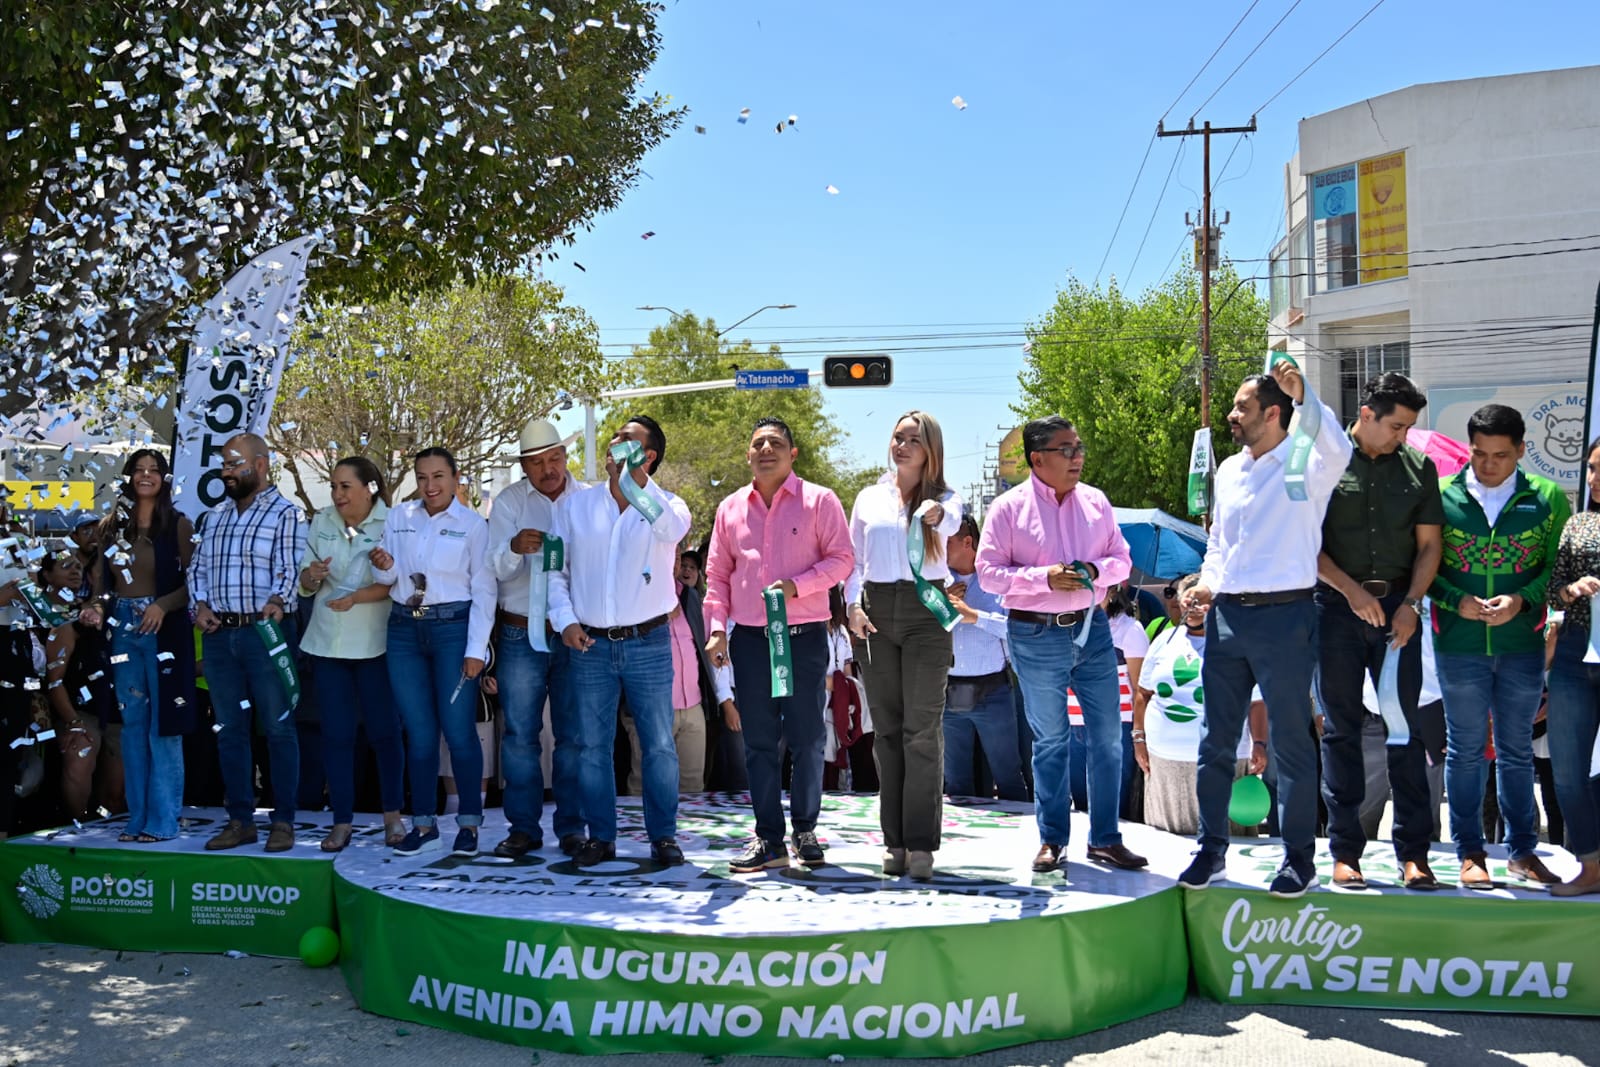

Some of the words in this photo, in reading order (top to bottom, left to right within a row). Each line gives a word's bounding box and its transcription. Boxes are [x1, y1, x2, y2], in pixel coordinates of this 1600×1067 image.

[736, 375, 748, 385] Av.
[748, 374, 795, 384] Tatanacho
[1532, 399, 1562, 421] DRA.
[1526, 440, 1555, 475] CLÍNICA
[372, 884, 576, 897] GOBIERNO
[398, 871, 556, 886] PARA
[575, 879, 689, 888] LOS
[71, 897, 92, 905] PARA
[109, 899, 153, 907] POTOSINOS
[191, 882, 300, 905] SEDUVOP
[192, 905, 232, 913] SECRETARÍA
[244, 907, 286, 916] DESARROLLO
[1221, 897, 1363, 962] Contigo
[502, 940, 888, 988] INAUGURACIÓN
[1229, 952, 1313, 998] ¡YA
[1322, 955, 1394, 993] SE
[1398, 956, 1574, 998] NOTA!
[409, 974, 575, 1034] AVENIDA
[590, 1000, 763, 1037] HIMNO
[777, 991, 1026, 1039] NACIONAL
